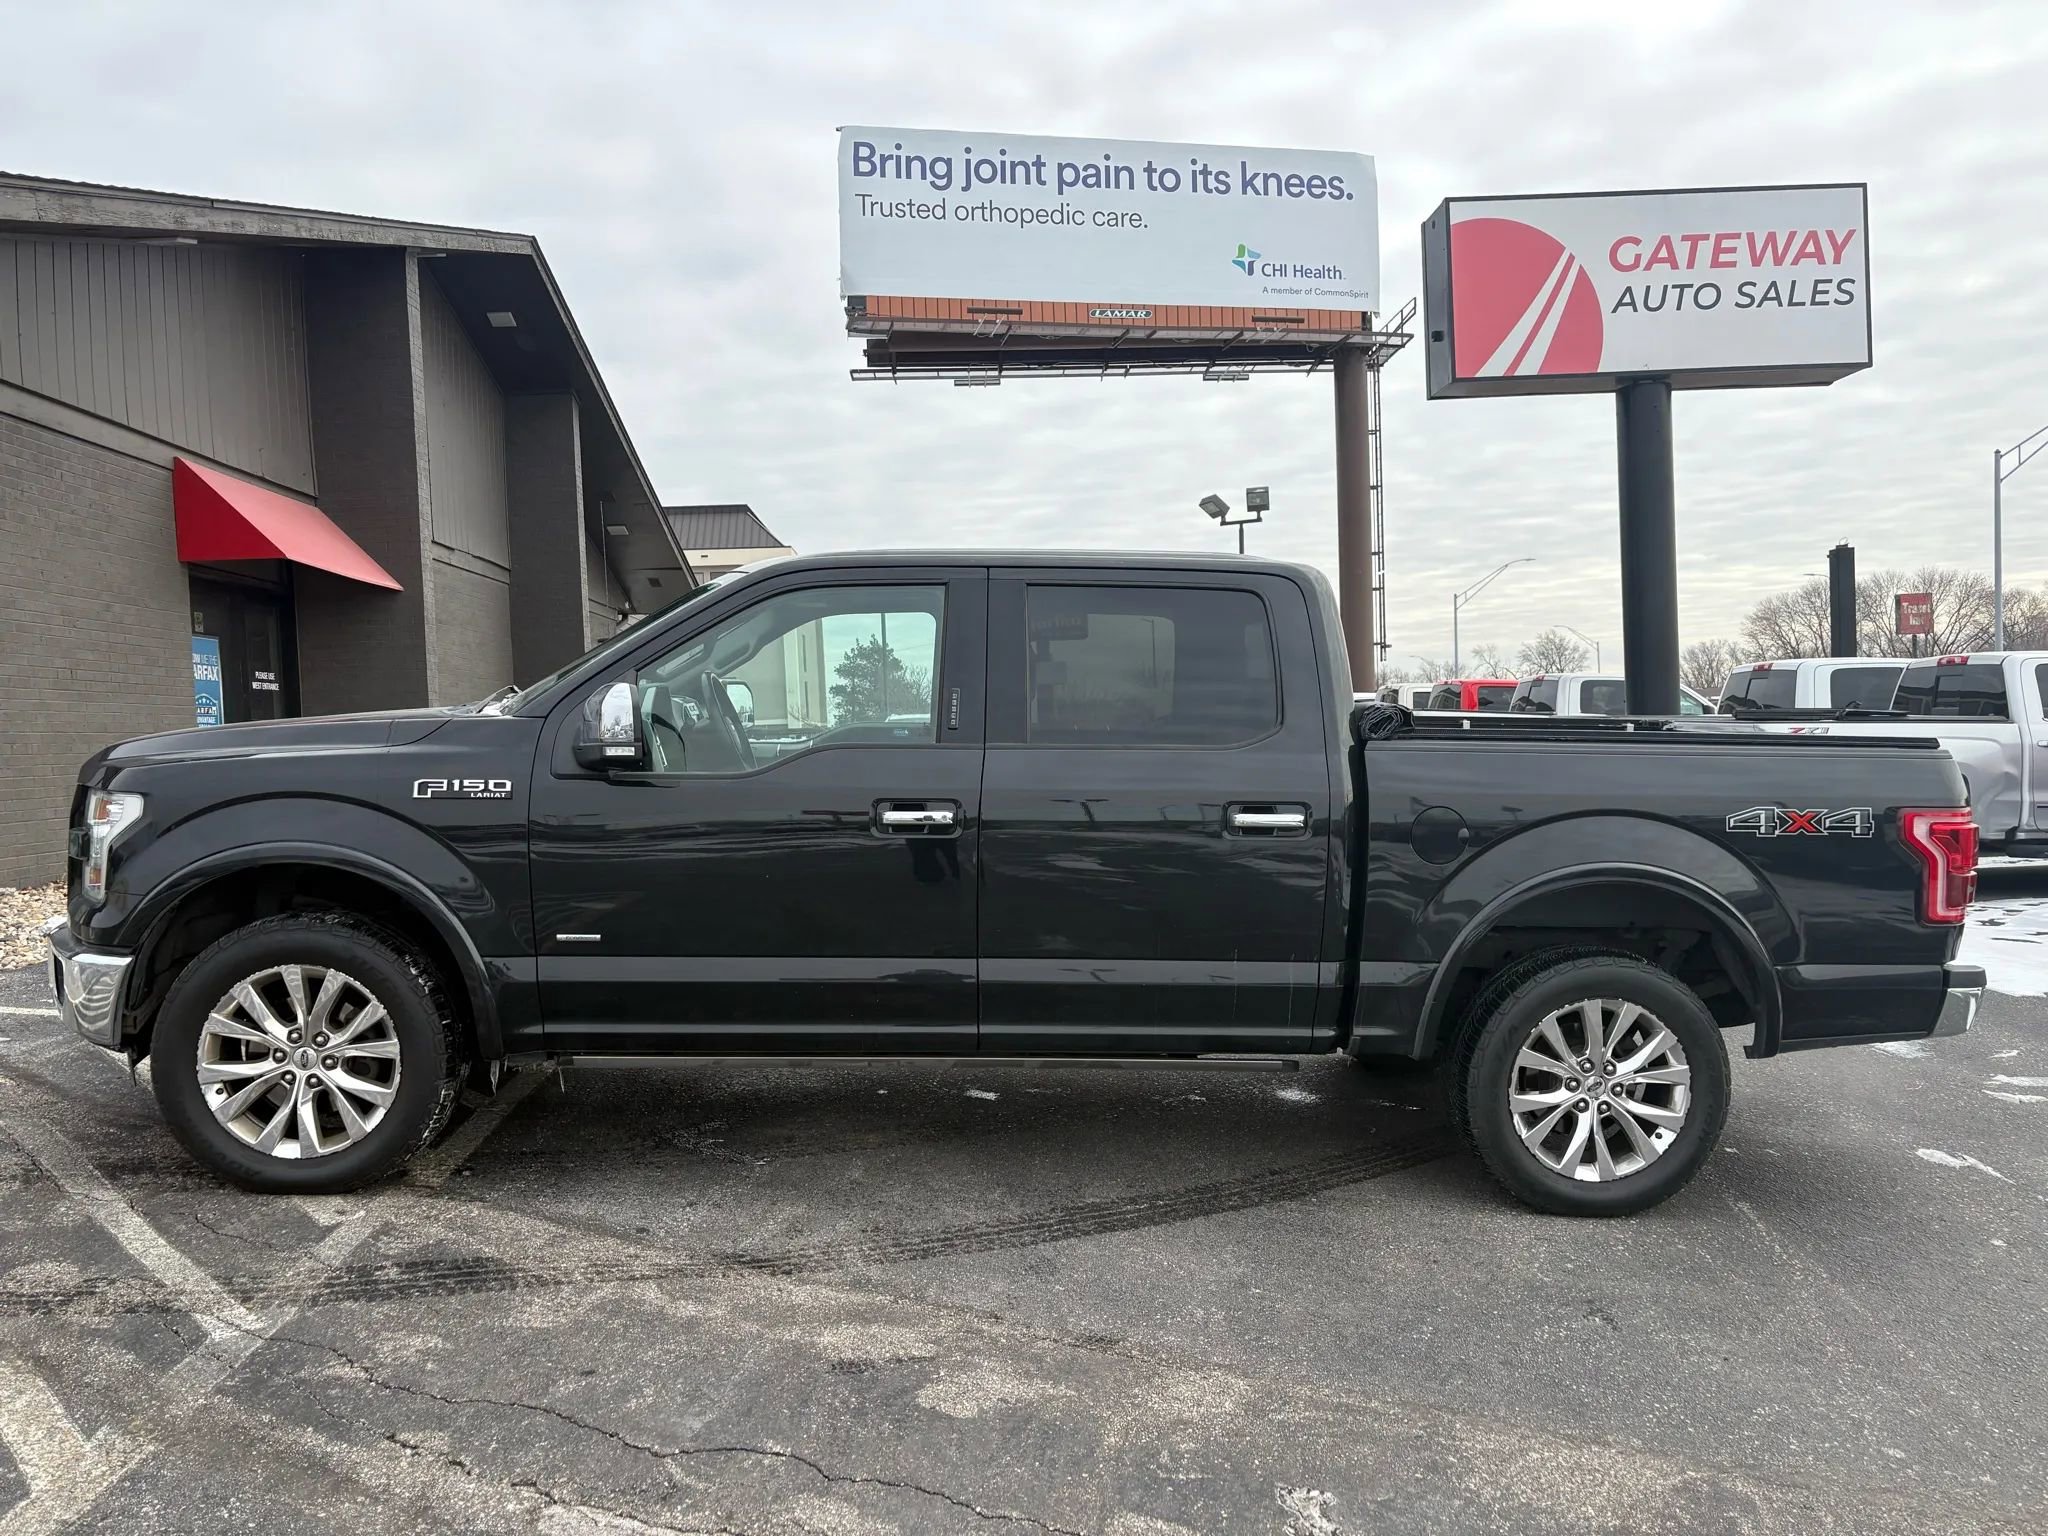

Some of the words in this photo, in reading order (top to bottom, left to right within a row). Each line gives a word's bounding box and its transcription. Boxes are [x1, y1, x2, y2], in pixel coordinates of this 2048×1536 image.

[853, 141, 952, 191] Bring
[961, 146, 1047, 192] joint
[1057, 153, 1135, 195] pain
[1143, 160, 1181, 193] to
[1190, 158, 1231, 195] its
[1241, 161, 1354, 201] knees.
[855, 193, 946, 220] Trusted
[954, 199, 1085, 229] orthopedic
[1092, 210, 1148, 229] care.
[1608, 228, 1857, 273] GATEWAY
[1261, 263, 1287, 278] CHI
[1293, 264, 1342, 280] Health
[1262, 286, 1269, 294] A
[1270, 286, 1303, 296] member
[1304, 287, 1313, 296] of
[1314, 287, 1369, 299] CommonSpirit
[1611, 282, 1722, 314] AUTO
[1734, 278, 1856, 310] SALES
[1095, 310, 1146, 318] LAMAR
[193, 664, 219, 681] ARFAX
